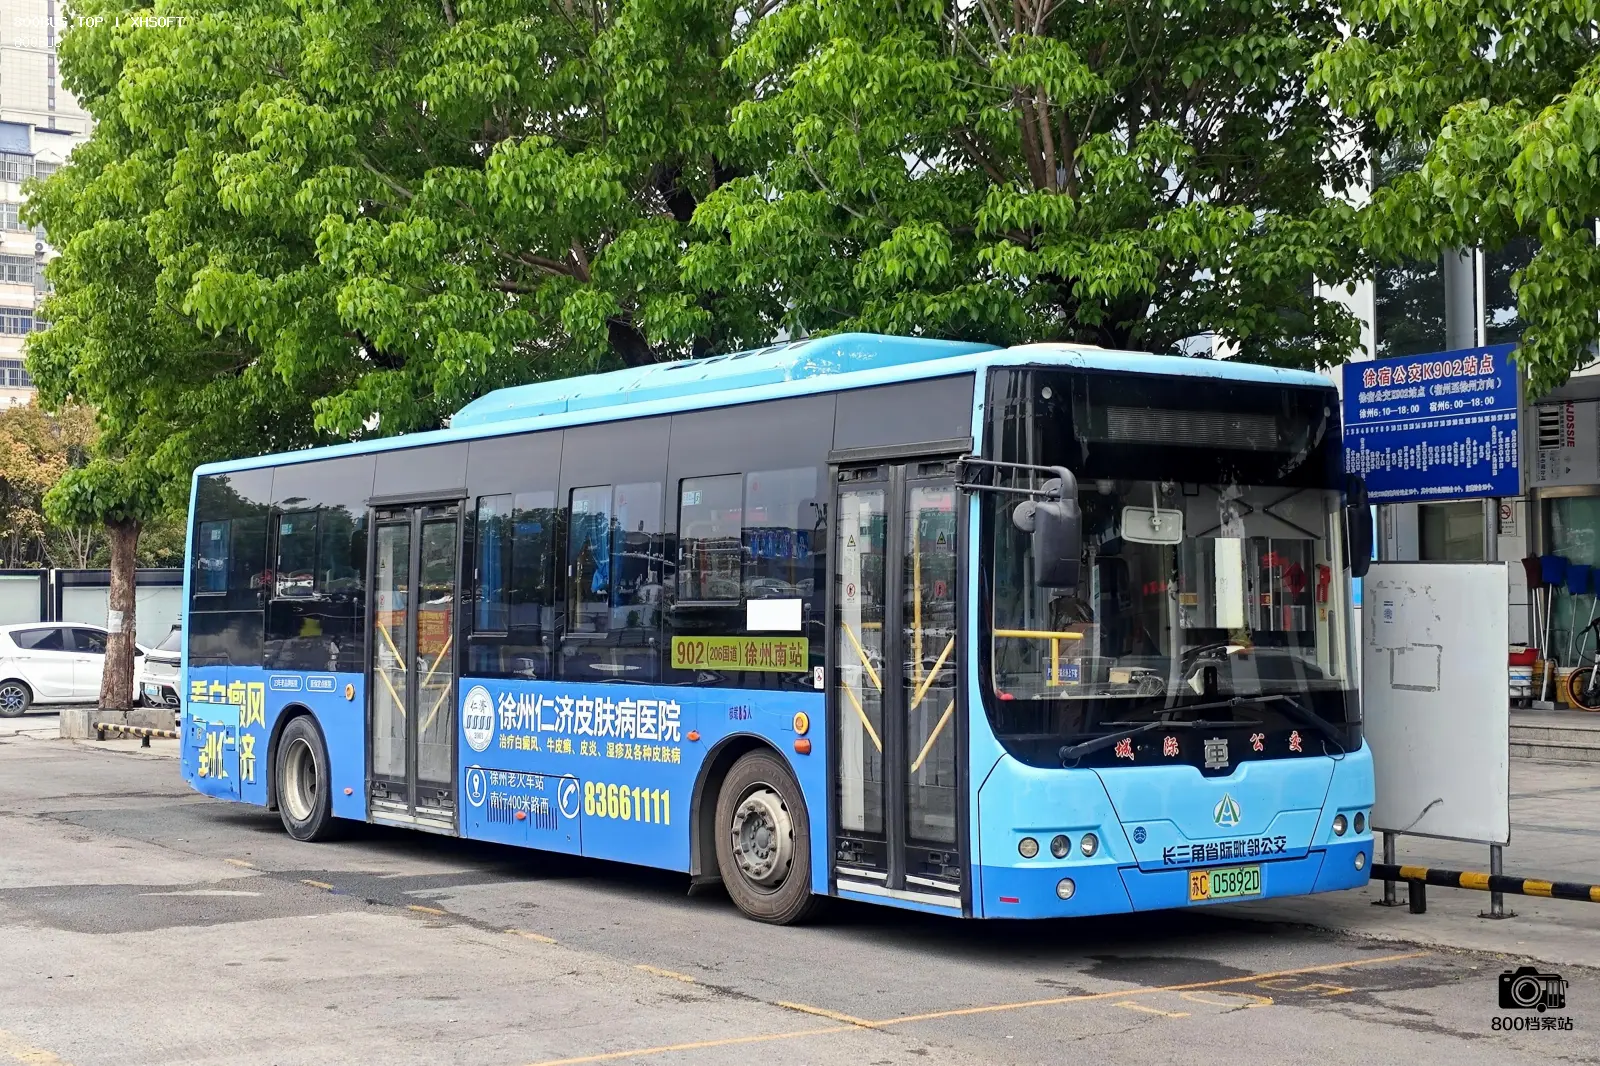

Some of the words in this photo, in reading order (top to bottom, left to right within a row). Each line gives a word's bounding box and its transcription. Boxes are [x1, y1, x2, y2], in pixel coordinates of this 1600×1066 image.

[1363, 353, 1494, 388] 徐宿公交K902站点
[498, 692, 681, 742] 徐州仁济皮肤病医院
[490, 770, 545, 791] 徐州老火车站
[490, 791, 549, 815] 南行400米路西
[584, 781, 670, 826] 83661111
[1162, 836, 1287, 866] 长三角省际毗邻公交
